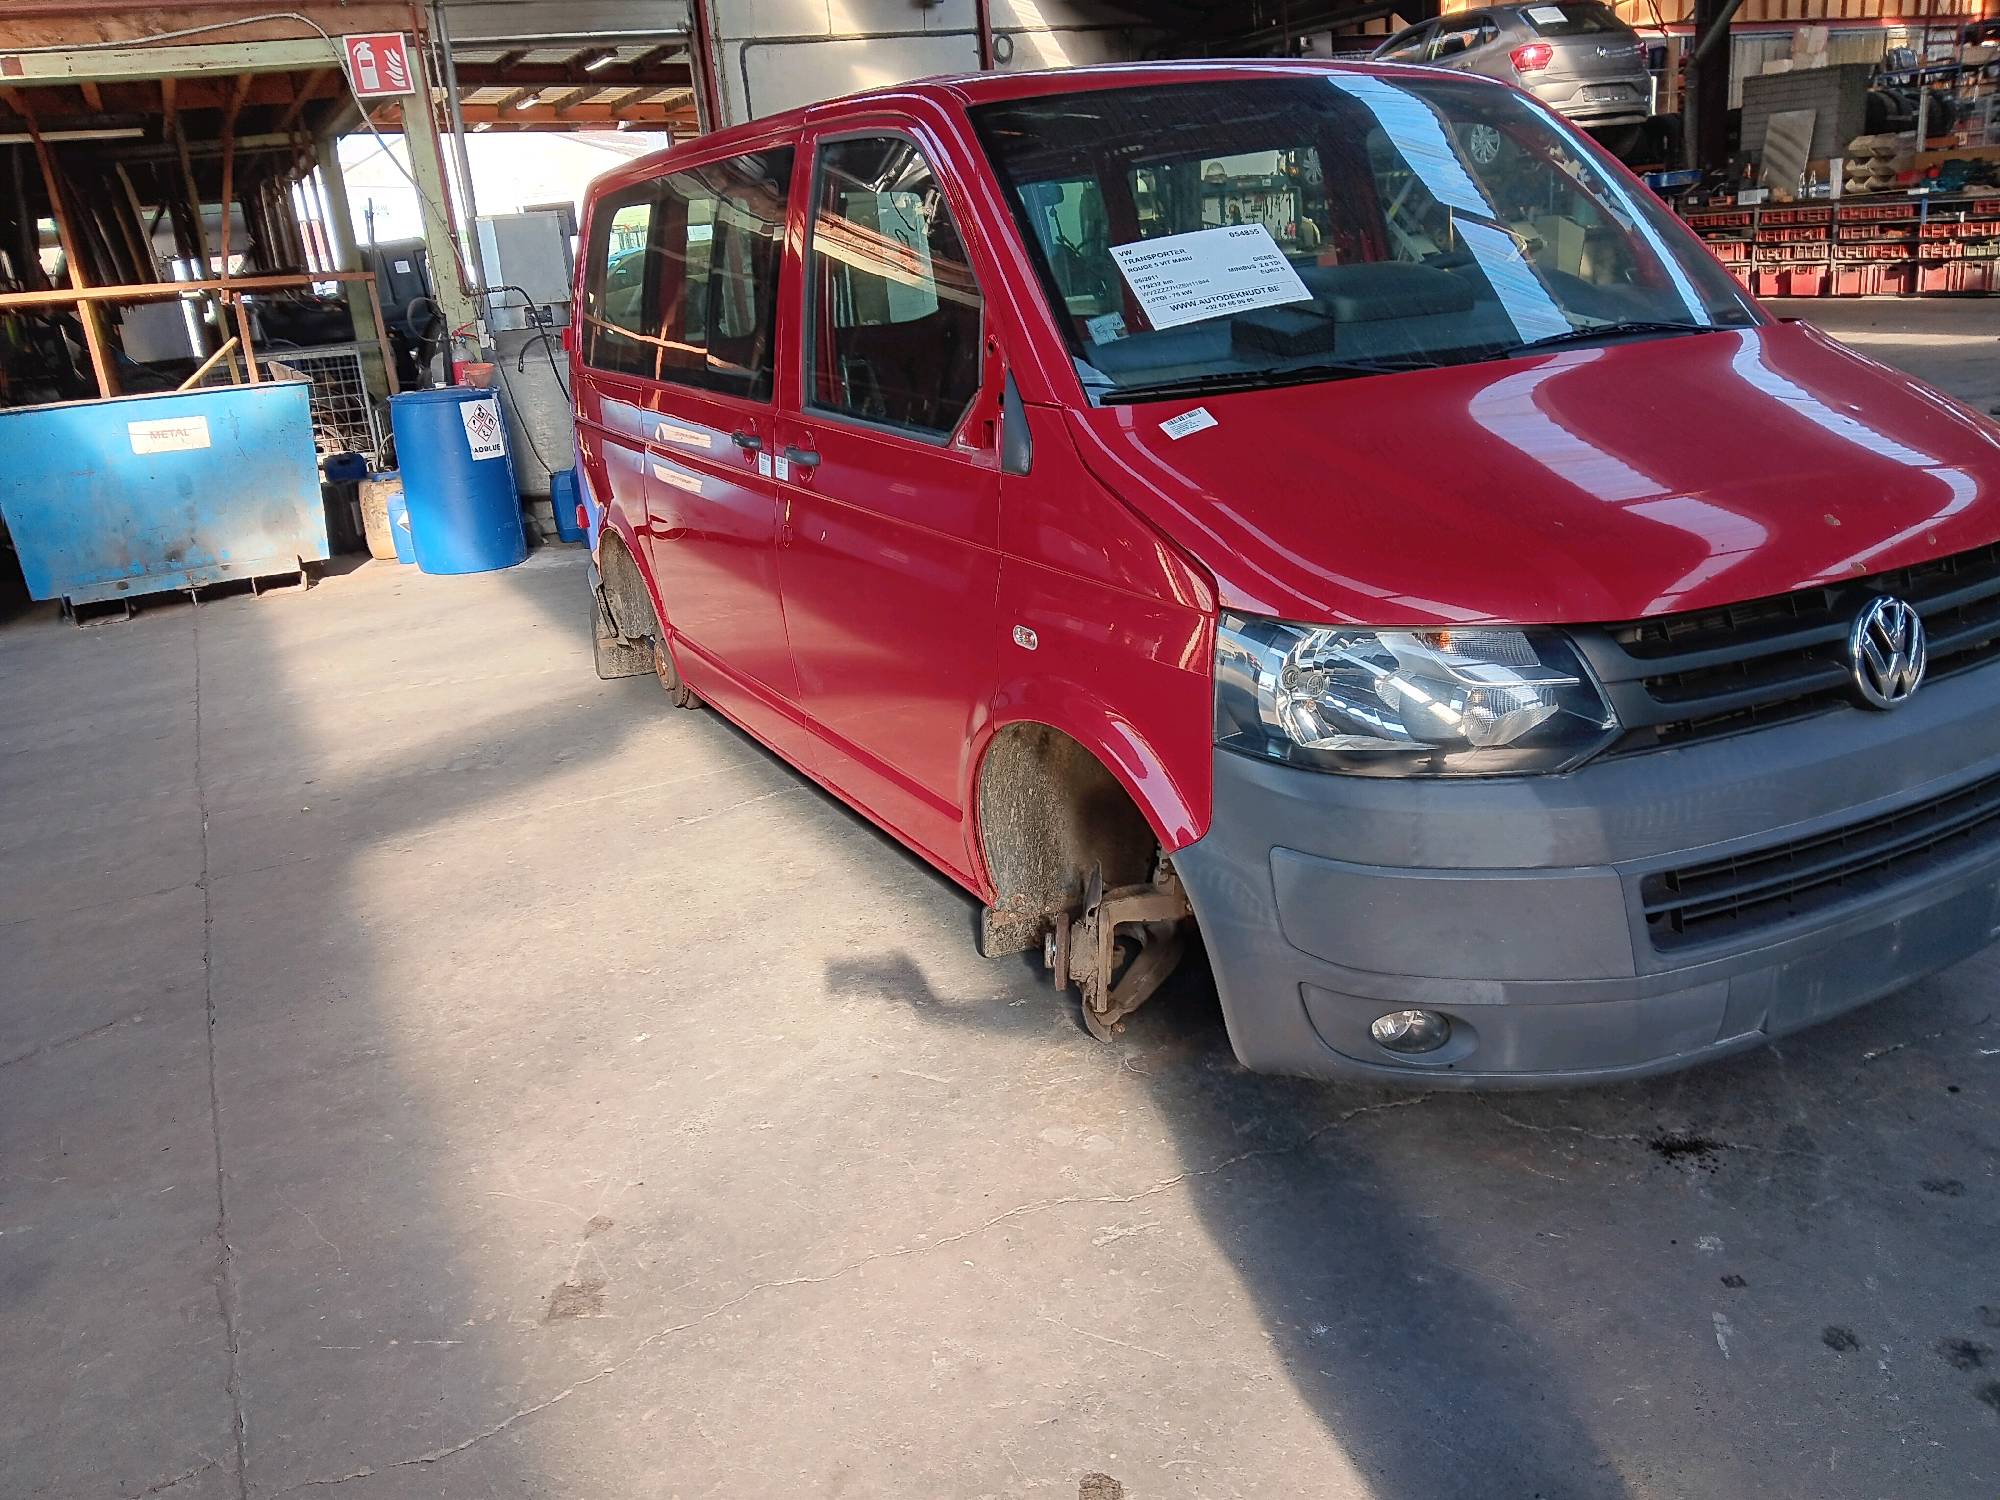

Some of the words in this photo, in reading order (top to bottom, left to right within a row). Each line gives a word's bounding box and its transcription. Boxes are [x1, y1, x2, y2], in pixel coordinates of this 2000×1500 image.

[1118, 249, 1132, 257] VW
[1122, 248, 1187, 266] TRANSPORTER
[1127, 264, 1154, 273] ROUGE
[1172, 255, 1193, 264] MANU
[1169, 284, 1281, 312] WWW.AUTODEKNUDT.BE
[149, 428, 190, 439] METAL
[474, 443, 501, 453] ADBLUE
